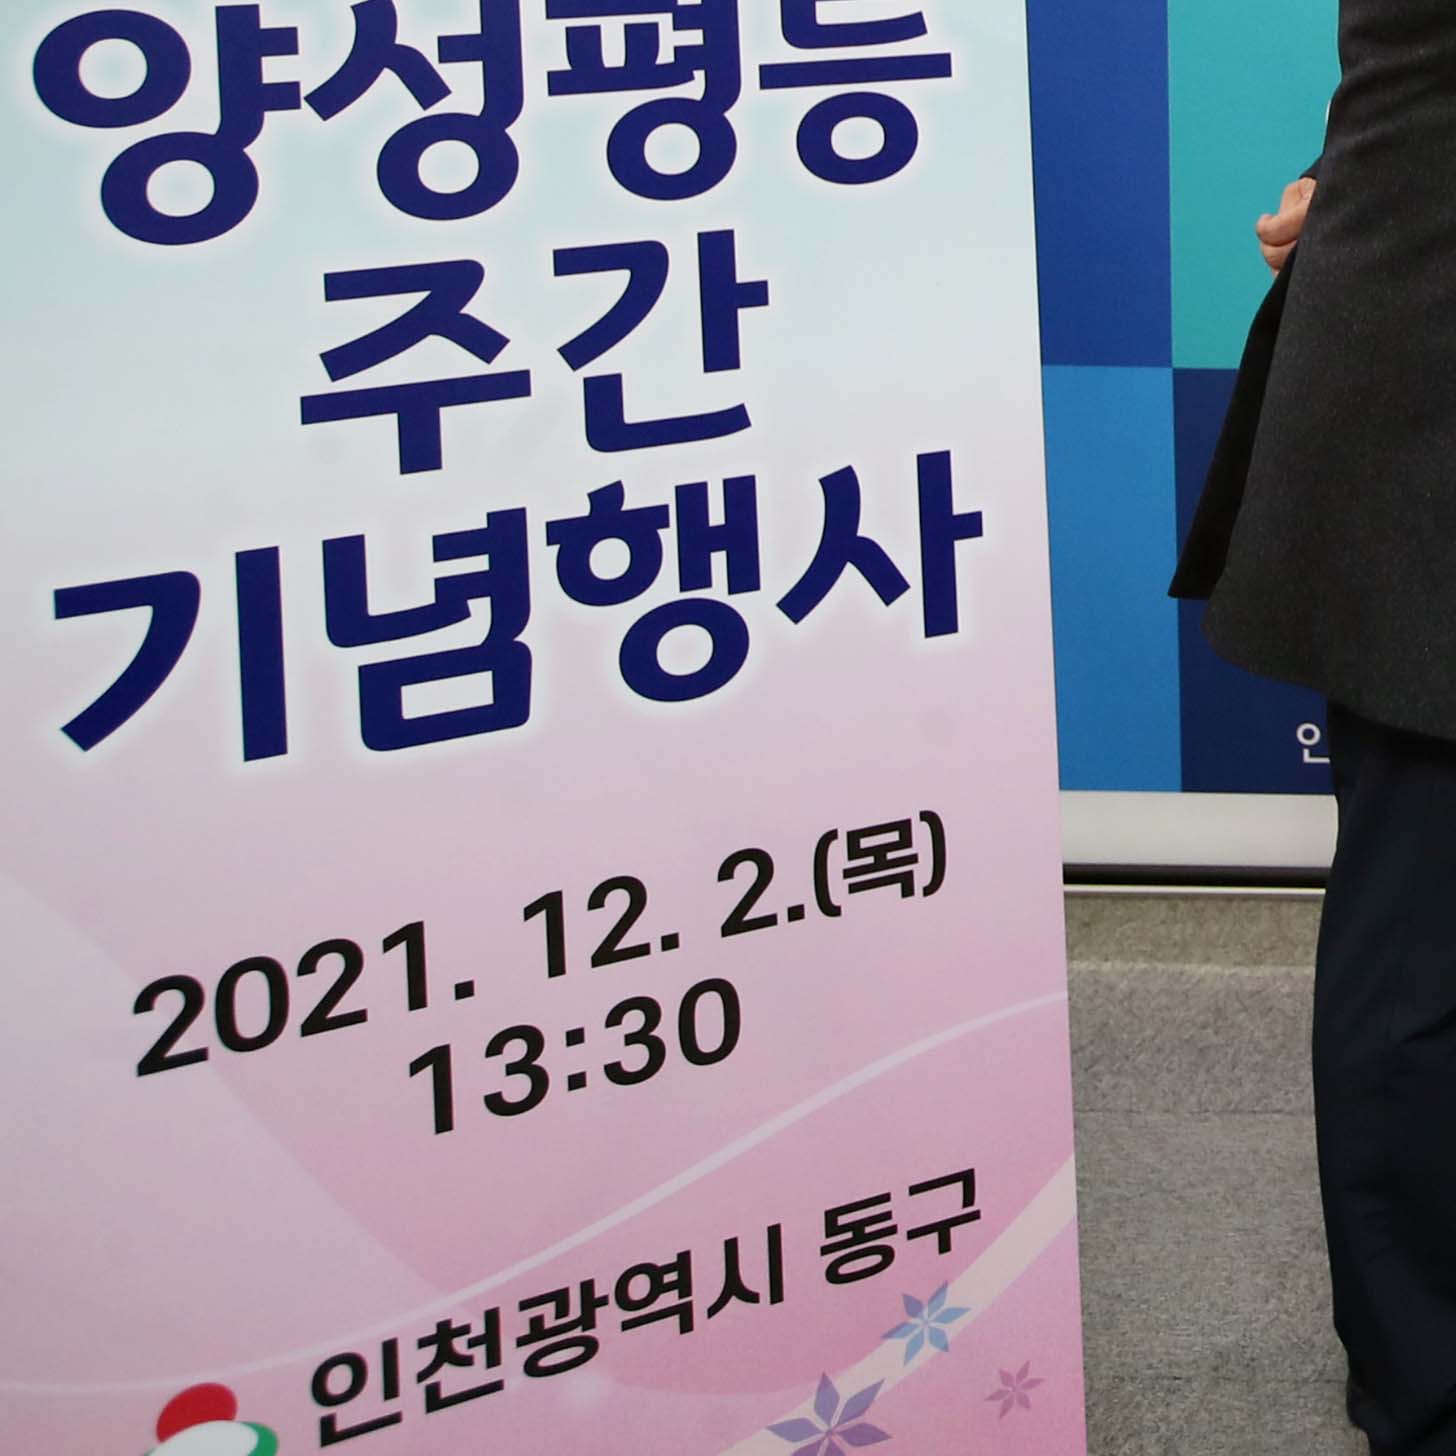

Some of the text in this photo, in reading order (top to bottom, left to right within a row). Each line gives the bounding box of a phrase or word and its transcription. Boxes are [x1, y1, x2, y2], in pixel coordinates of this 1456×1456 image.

[299, 228, 771, 477] 주간
[52, 448, 985, 763] 기념행사
[131, 919, 476, 1078] 2021.
[521, 874, 682, 980] 12.
[407, 977, 744, 1136] 13:30
[310, 1167, 984, 1449] 인천광역시 동구
